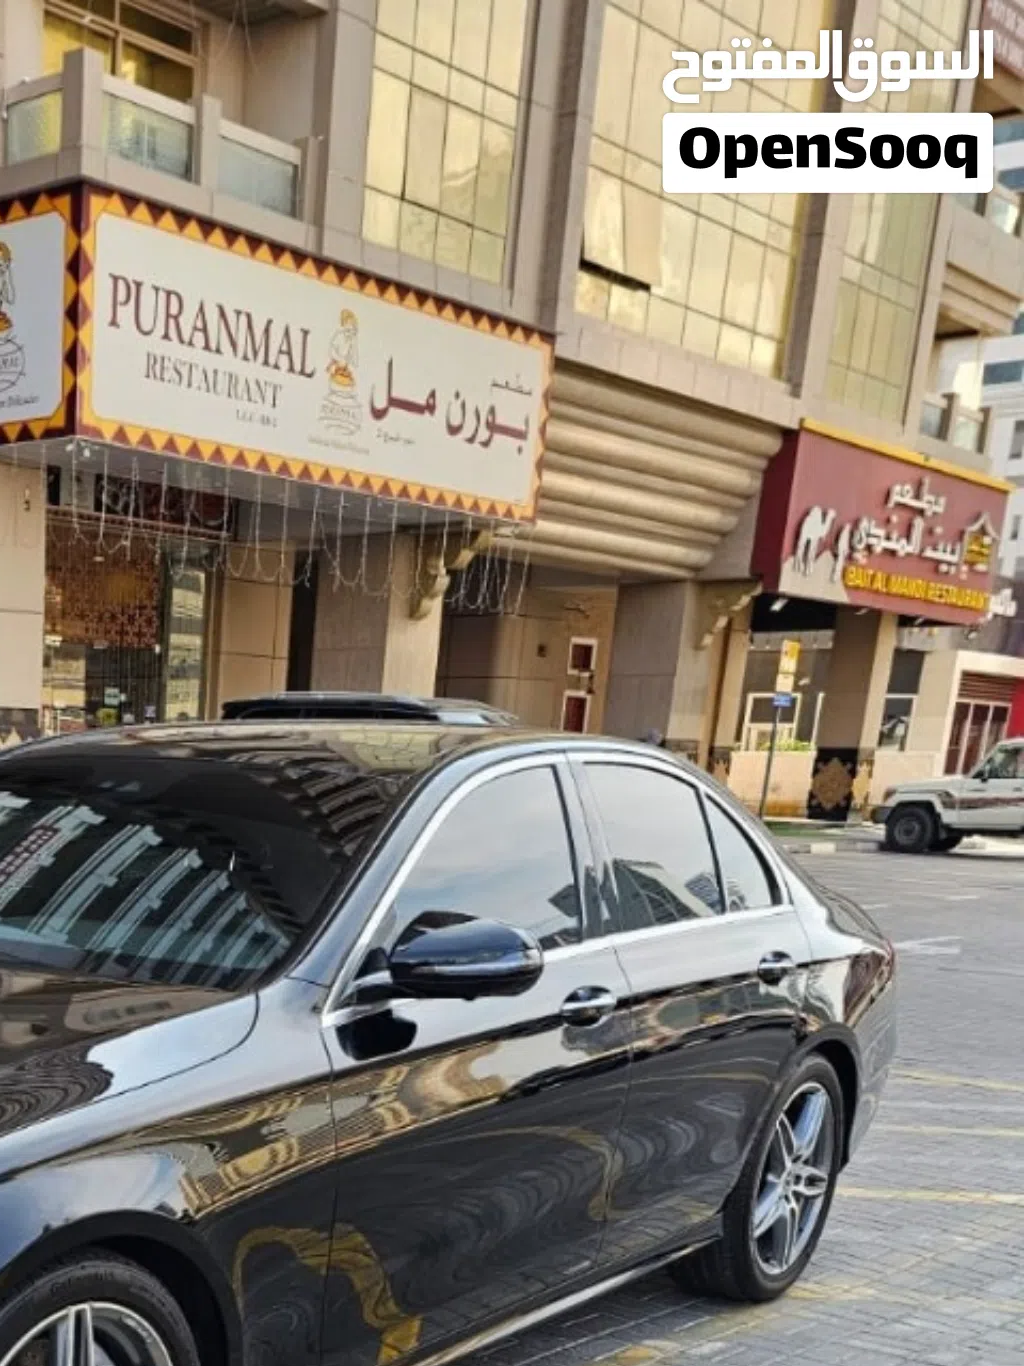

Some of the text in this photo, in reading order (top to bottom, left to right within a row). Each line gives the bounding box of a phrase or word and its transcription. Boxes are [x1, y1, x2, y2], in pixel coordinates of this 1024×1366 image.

[108, 272, 317, 379] PURANMAL
[144, 350, 283, 409] RESTAURANT
[369, 355, 530, 456] بورن مل
[887, 475, 947, 516] مطعم
